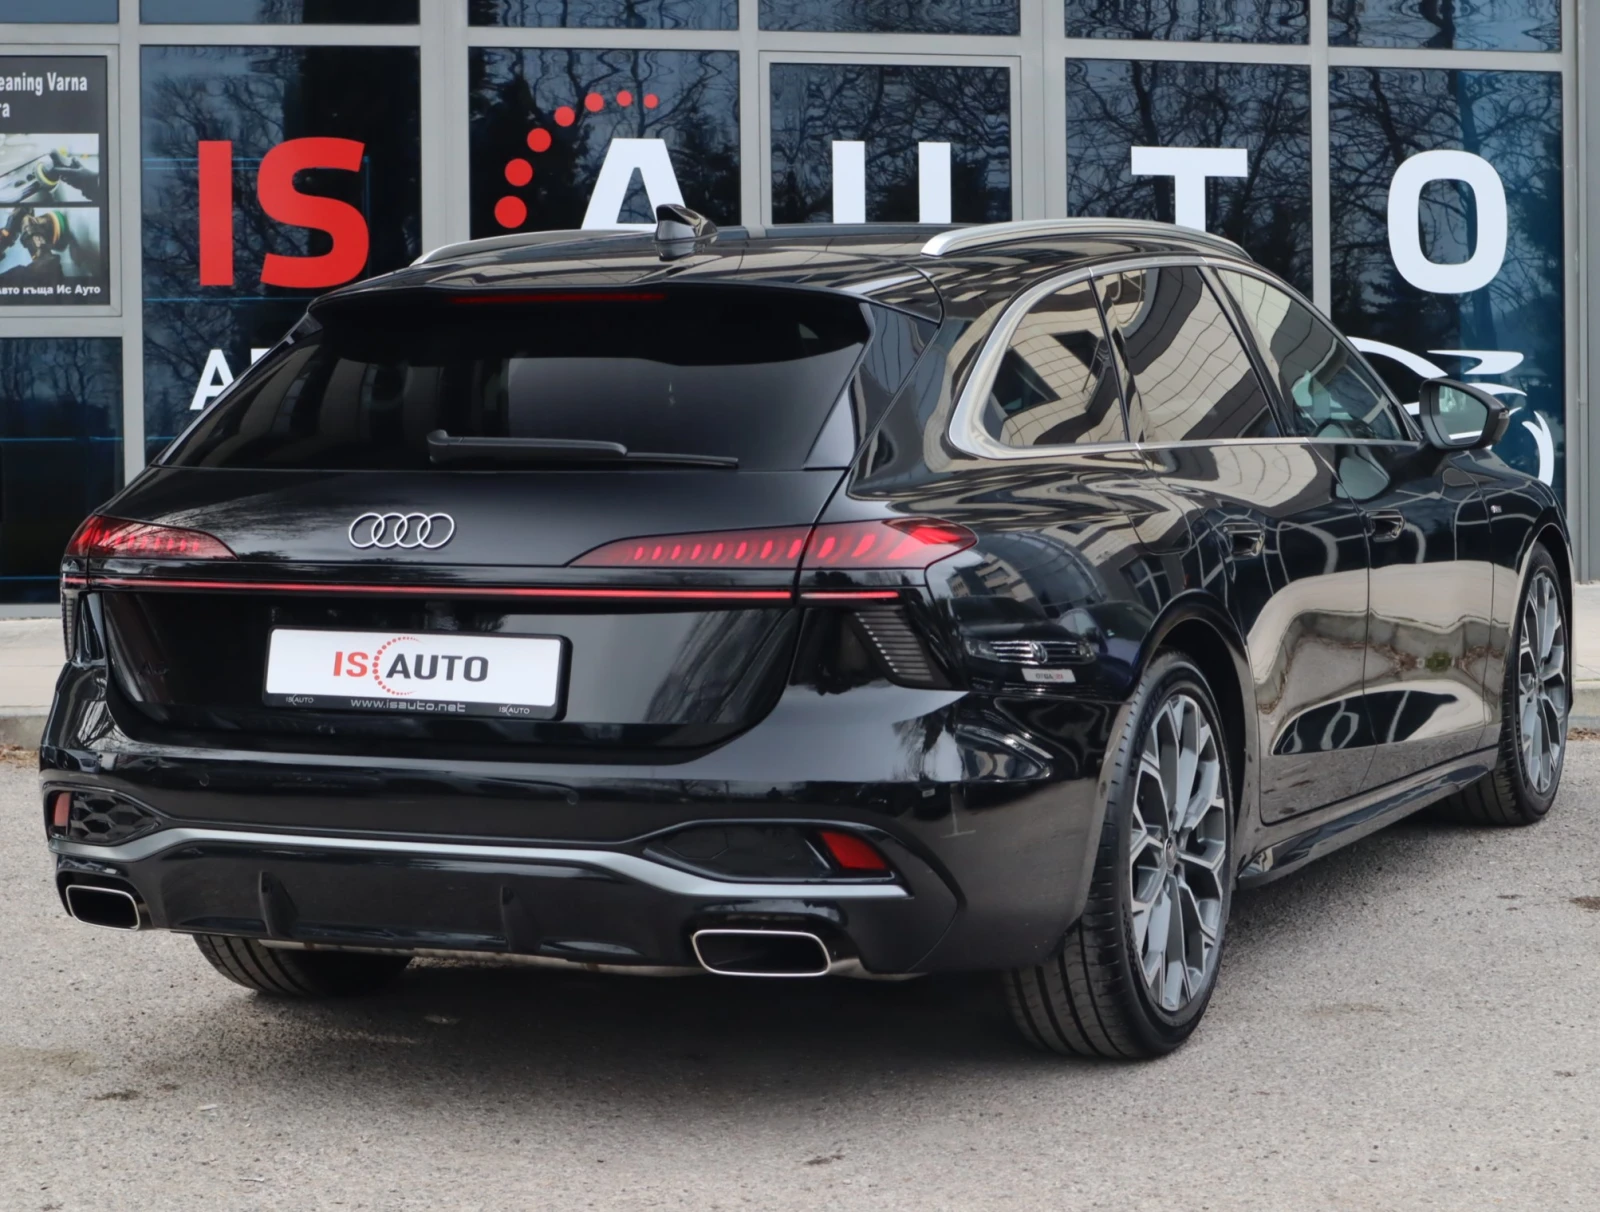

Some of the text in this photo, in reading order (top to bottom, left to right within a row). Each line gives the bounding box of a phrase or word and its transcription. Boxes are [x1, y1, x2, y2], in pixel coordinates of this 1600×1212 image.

[47, 72, 88, 91] Varna
[197, 136, 369, 288] IS
[23, 286, 54, 296] къща
[56, 284, 72, 294] Ис
[75, 284, 101, 296] Ауто
[333, 651, 489, 682] IS AUTO
[350, 699, 466, 713] www.isauto.net
